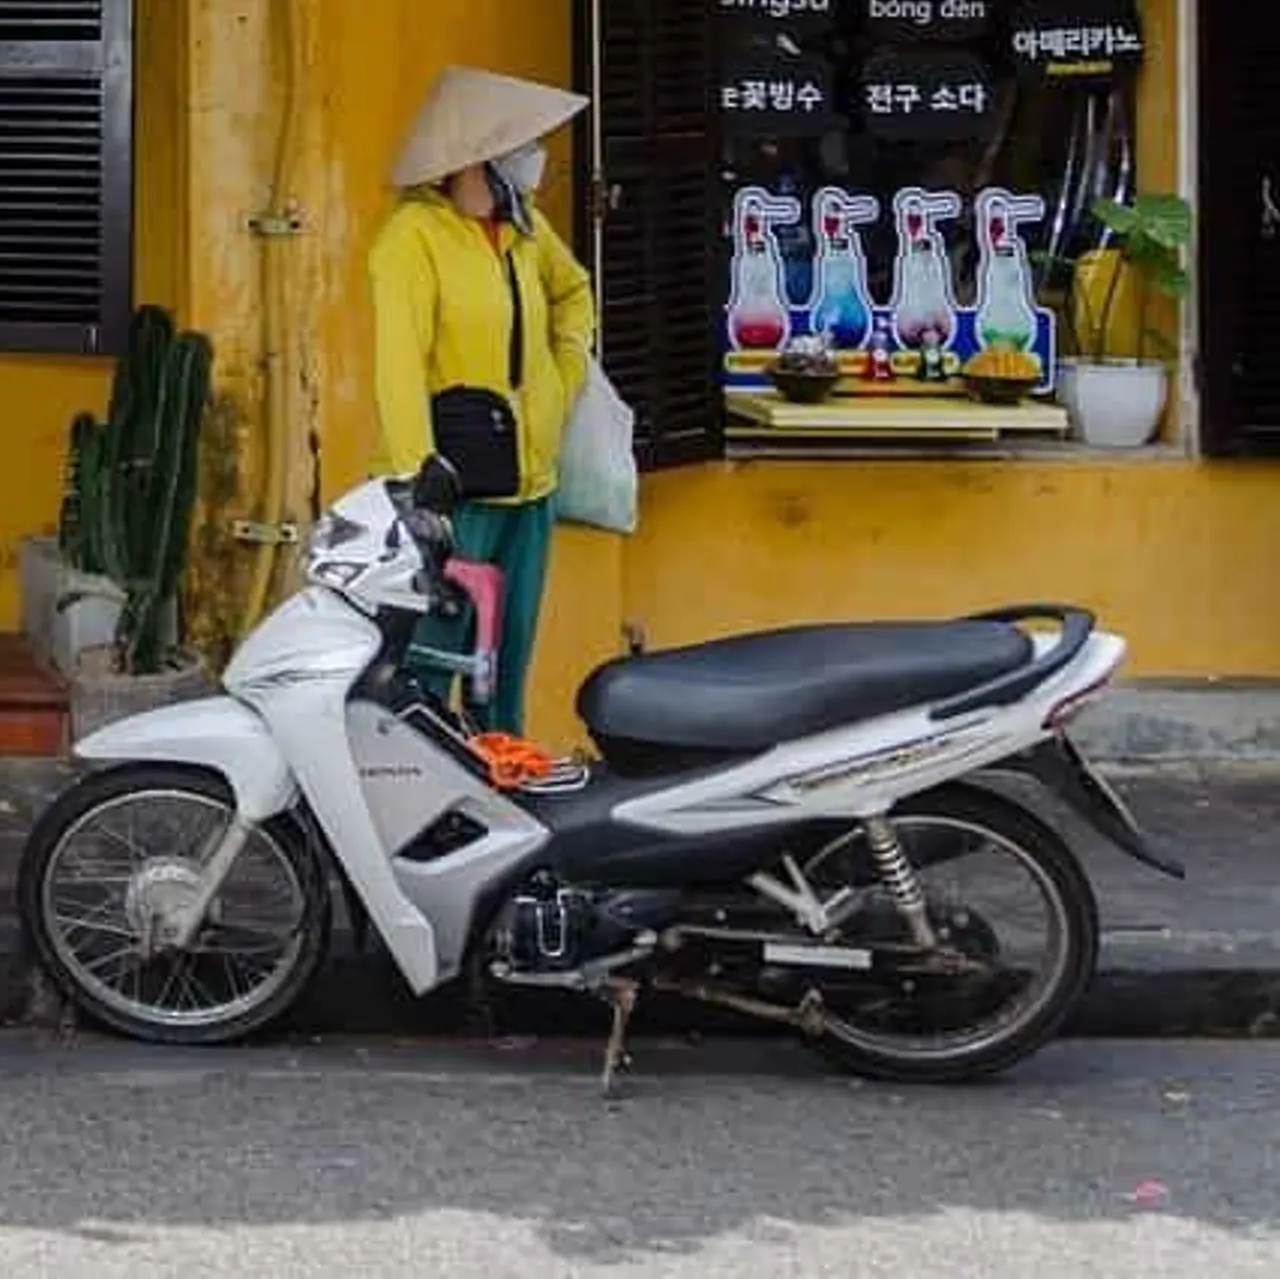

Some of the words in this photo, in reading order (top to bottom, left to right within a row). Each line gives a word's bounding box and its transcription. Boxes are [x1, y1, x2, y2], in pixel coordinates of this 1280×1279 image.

[1012, 25, 1141, 60] 아메리카노
[866, 84, 921, 113] 전구
[931, 84, 989, 113] 소다
